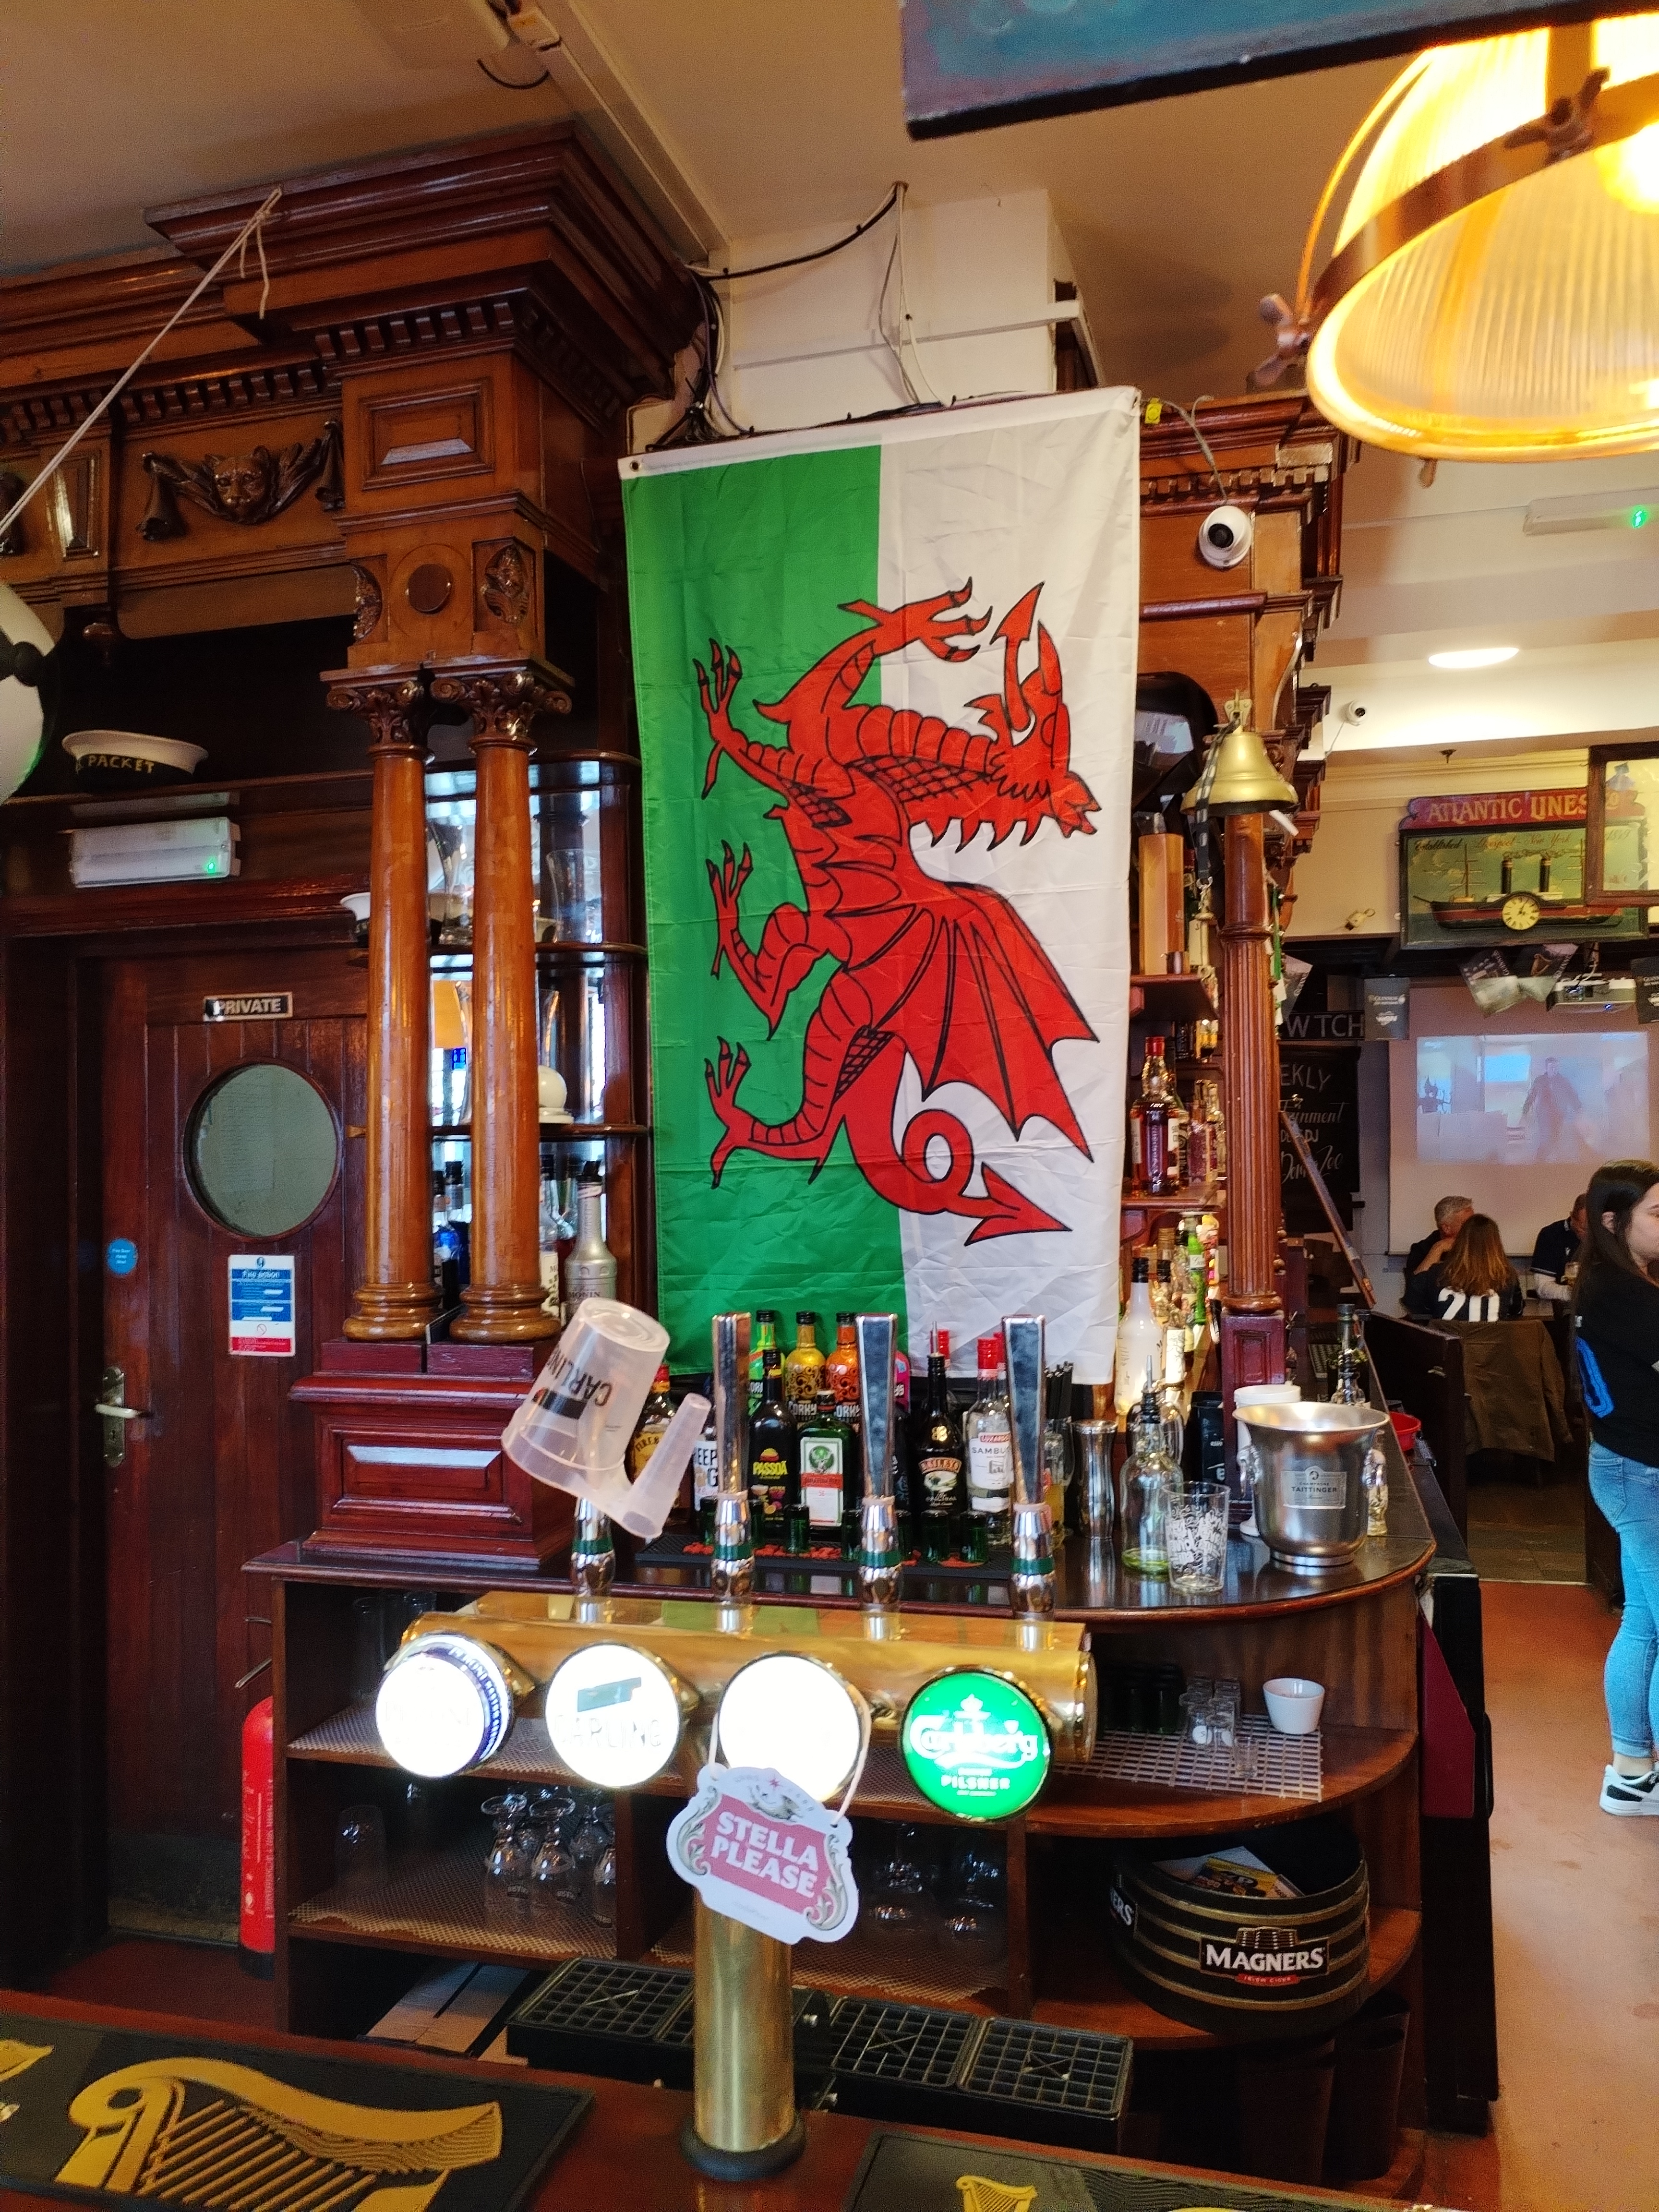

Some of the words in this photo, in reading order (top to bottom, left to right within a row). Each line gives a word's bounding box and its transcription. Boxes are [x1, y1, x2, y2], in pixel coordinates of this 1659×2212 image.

[88, 755, 154, 773] PACKET
[1429, 797, 1522, 825] ATLANTIC
[1529, 793, 1587, 820] LINES
[213, 998, 281, 1015] PRIVATE
[1280, 1063, 1331, 1093] EKLY
[789, 1400, 817, 1416] CORKY
[635, 1435, 660, 1452] FIREB
[910, 1715, 1038, 1761] Carlsberg
[941, 1775, 1010, 1790] PILSNER
[716, 1811, 818, 1871] STELLA
[710, 1835, 817, 1899] PLEASE
[1206, 1944, 1323, 1972] MAGNERS
